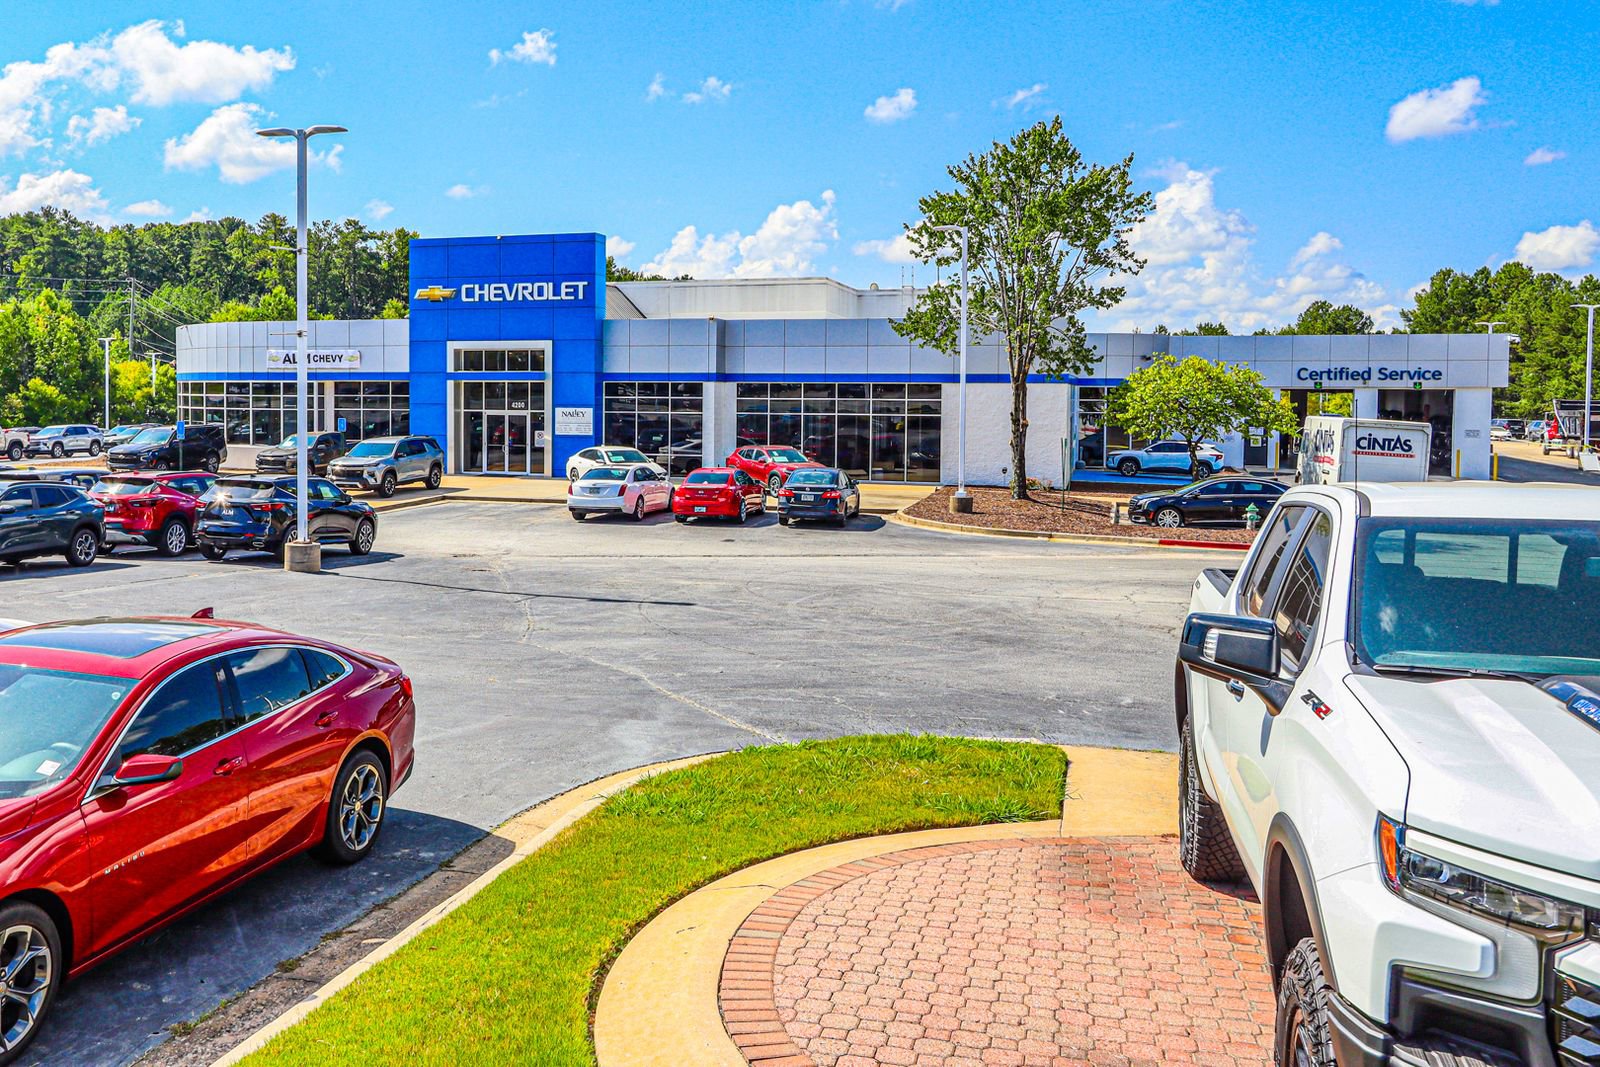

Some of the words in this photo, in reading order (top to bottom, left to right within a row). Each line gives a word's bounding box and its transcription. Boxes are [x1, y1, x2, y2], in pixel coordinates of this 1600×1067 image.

[461, 281, 588, 302] CHEVROLET
[312, 354, 344, 363] CHEVY
[1297, 367, 1372, 381] Certified
[1377, 367, 1442, 381] Service
